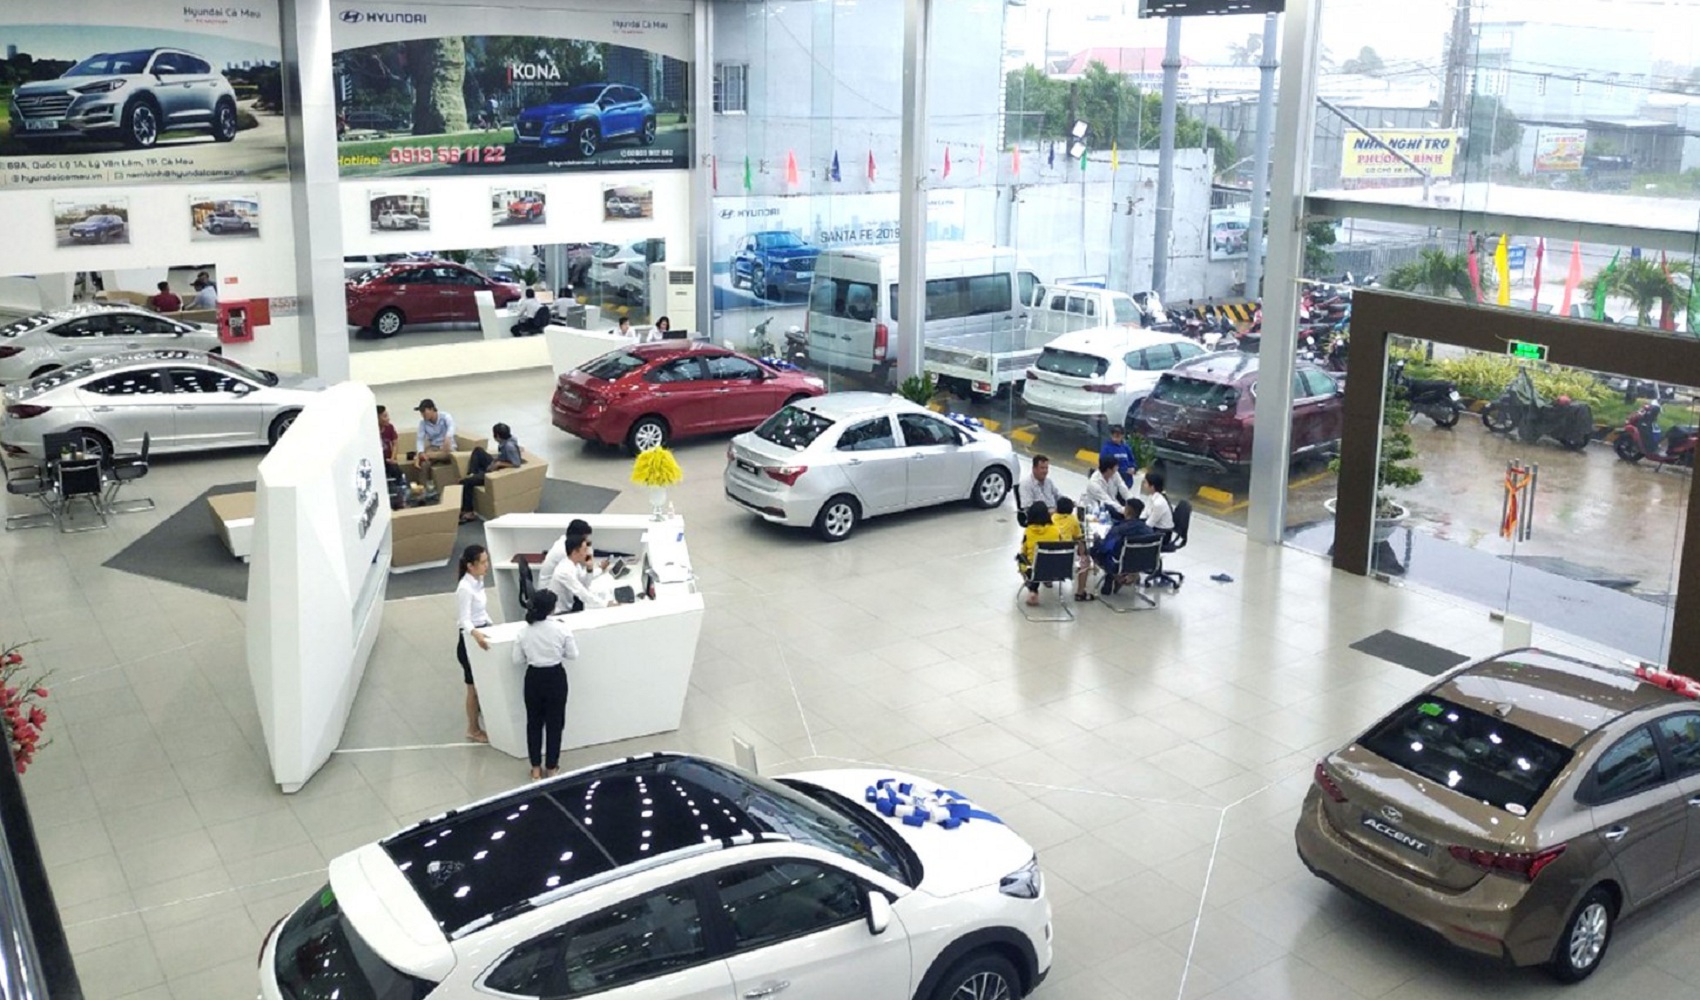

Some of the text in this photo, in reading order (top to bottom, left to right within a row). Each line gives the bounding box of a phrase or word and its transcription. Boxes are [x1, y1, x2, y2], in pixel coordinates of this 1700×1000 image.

[183, 7, 223, 18] Hyundai
[240, 9, 261, 19] Mau
[366, 12, 427, 23] HYUNDAI
[512, 63, 561, 80] KONA
[175, 157, 194, 166] Mau
[464, 146, 481, 164] 11
[484, 145, 507, 164] 22
[820, 227, 900, 243] SANTA FE 2019
[1363, 818, 1427, 850] ACCENT
